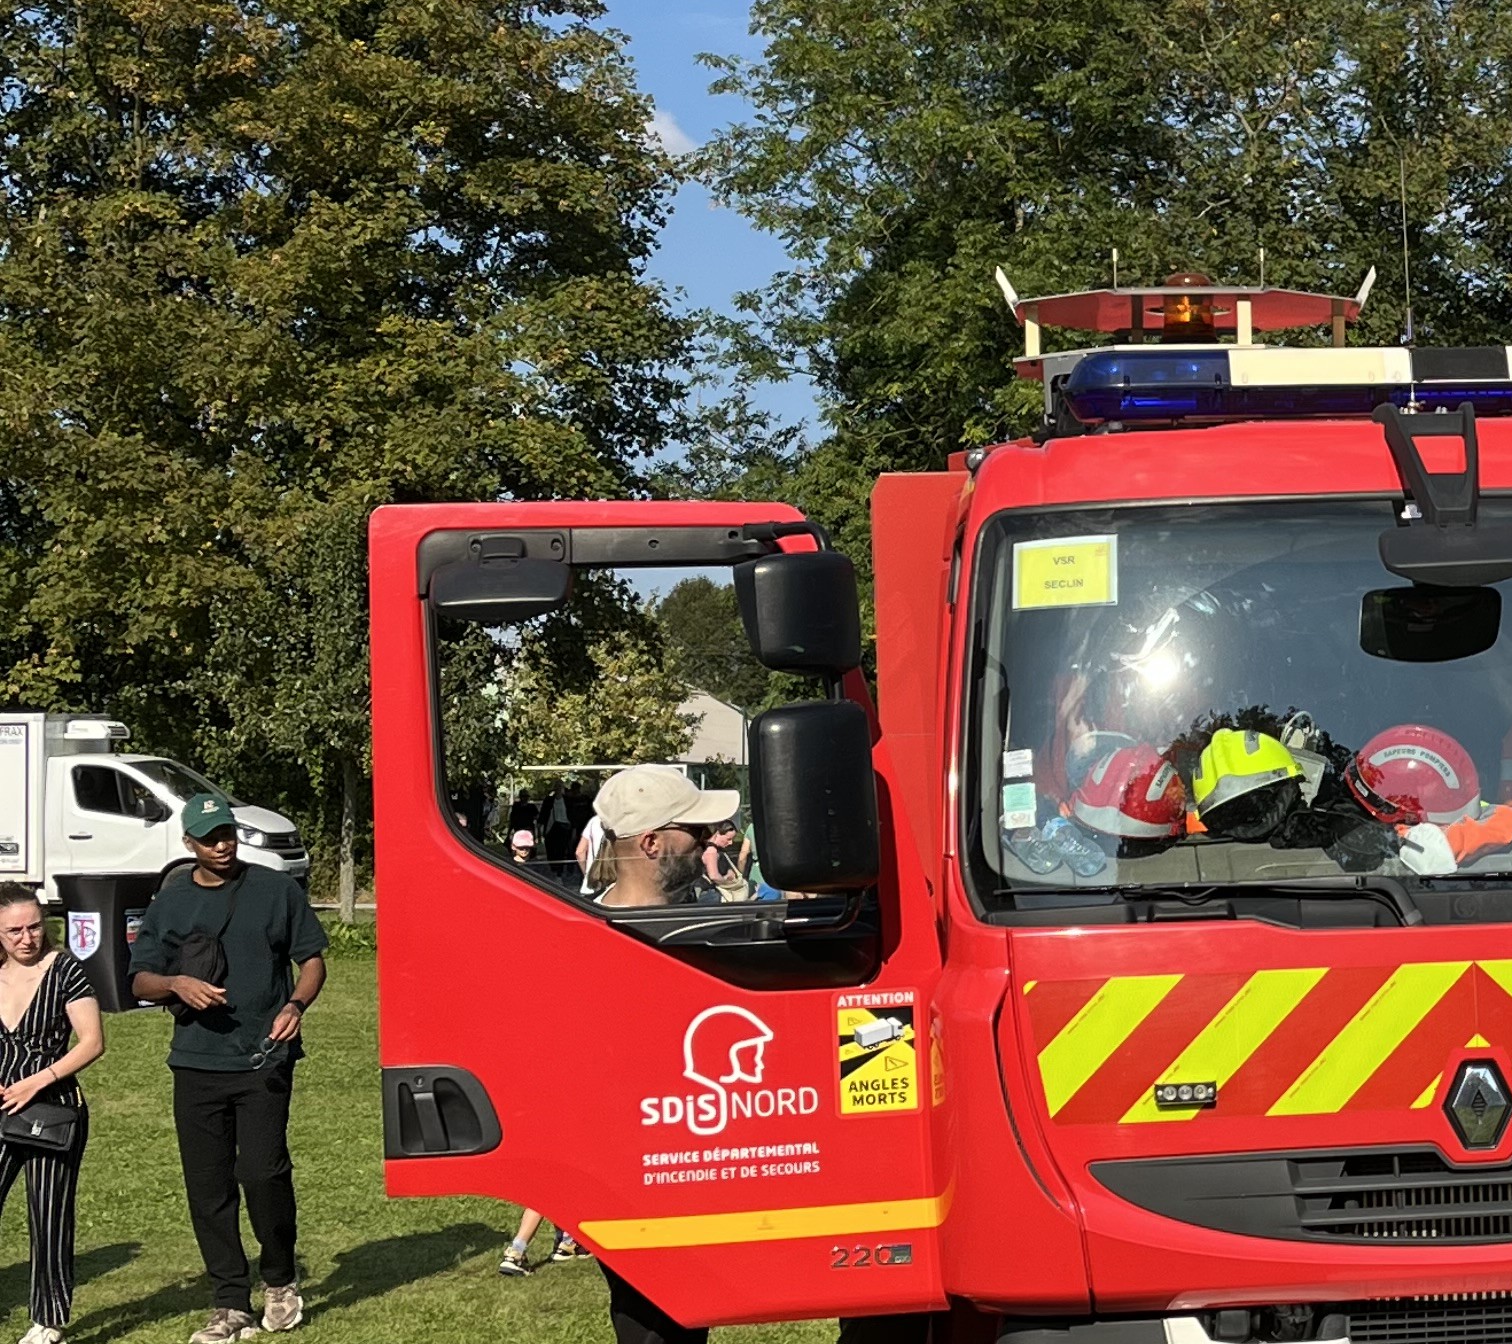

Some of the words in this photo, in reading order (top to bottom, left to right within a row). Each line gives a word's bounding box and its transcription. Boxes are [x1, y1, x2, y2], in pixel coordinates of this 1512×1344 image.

[1053, 555, 1076, 566] VSR
[1044, 579, 1084, 589] SECLIN
[837, 991, 914, 1007] ATTENTION
[849, 1077, 910, 1094] ANGLES
[731, 1086, 819, 1119] NORD
[852, 1092, 908, 1107] MORTS
[642, 1150, 700, 1167] SERVICE
[720, 1166, 736, 1181] ET
[740, 1165, 758, 1179] DE
[761, 1160, 820, 1177] SECOURS
[831, 1244, 893, 1269] 220
